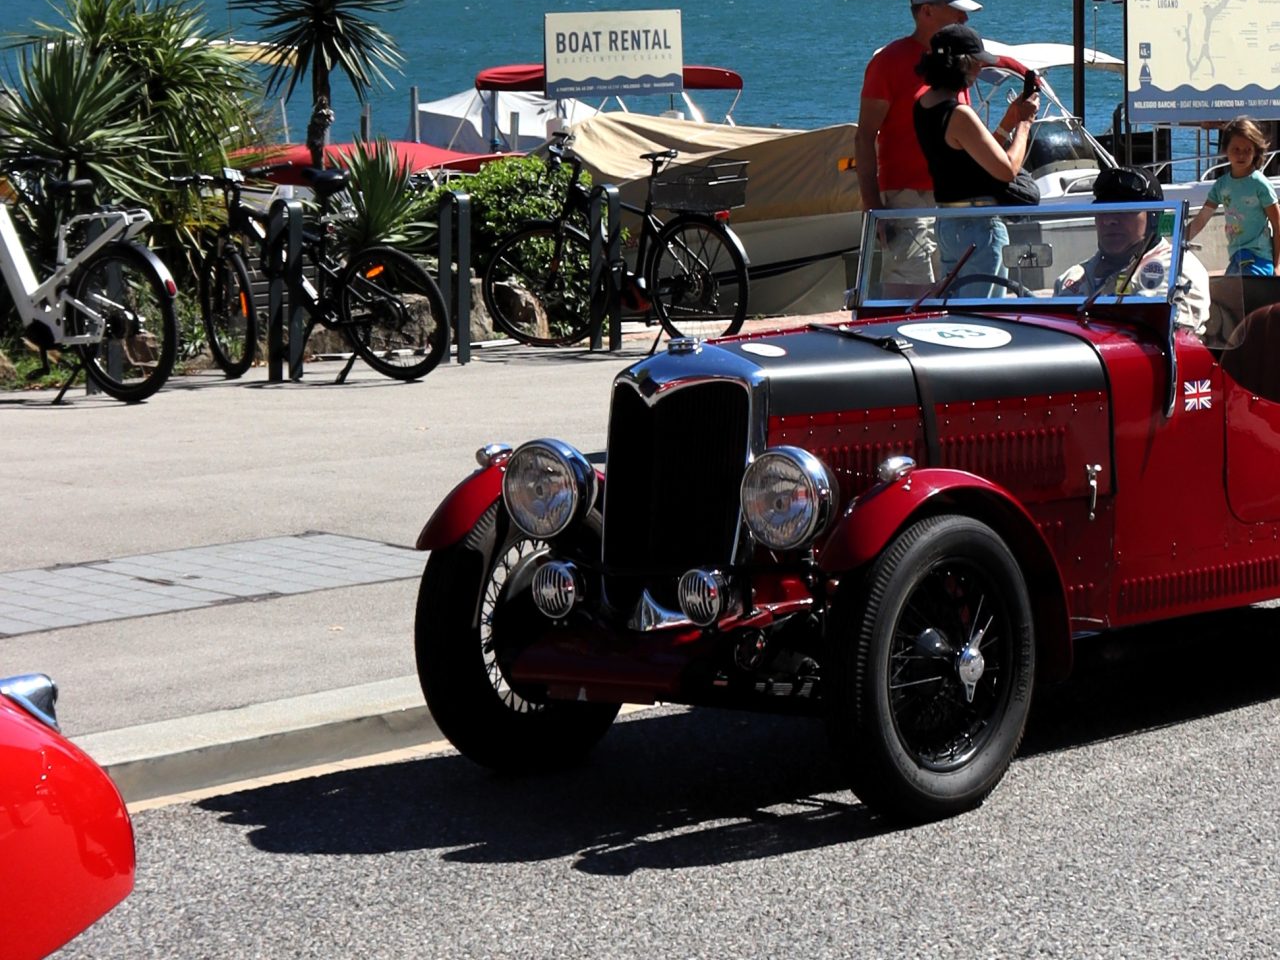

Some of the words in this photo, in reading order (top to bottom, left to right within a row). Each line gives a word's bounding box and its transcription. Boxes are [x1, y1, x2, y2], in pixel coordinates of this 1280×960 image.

[1157, 0, 1179, 9] LUGANO
[556, 31, 602, 54] BOAT
[608, 29, 671, 52] RENTAL
[937, 328, 987, 340] 43
